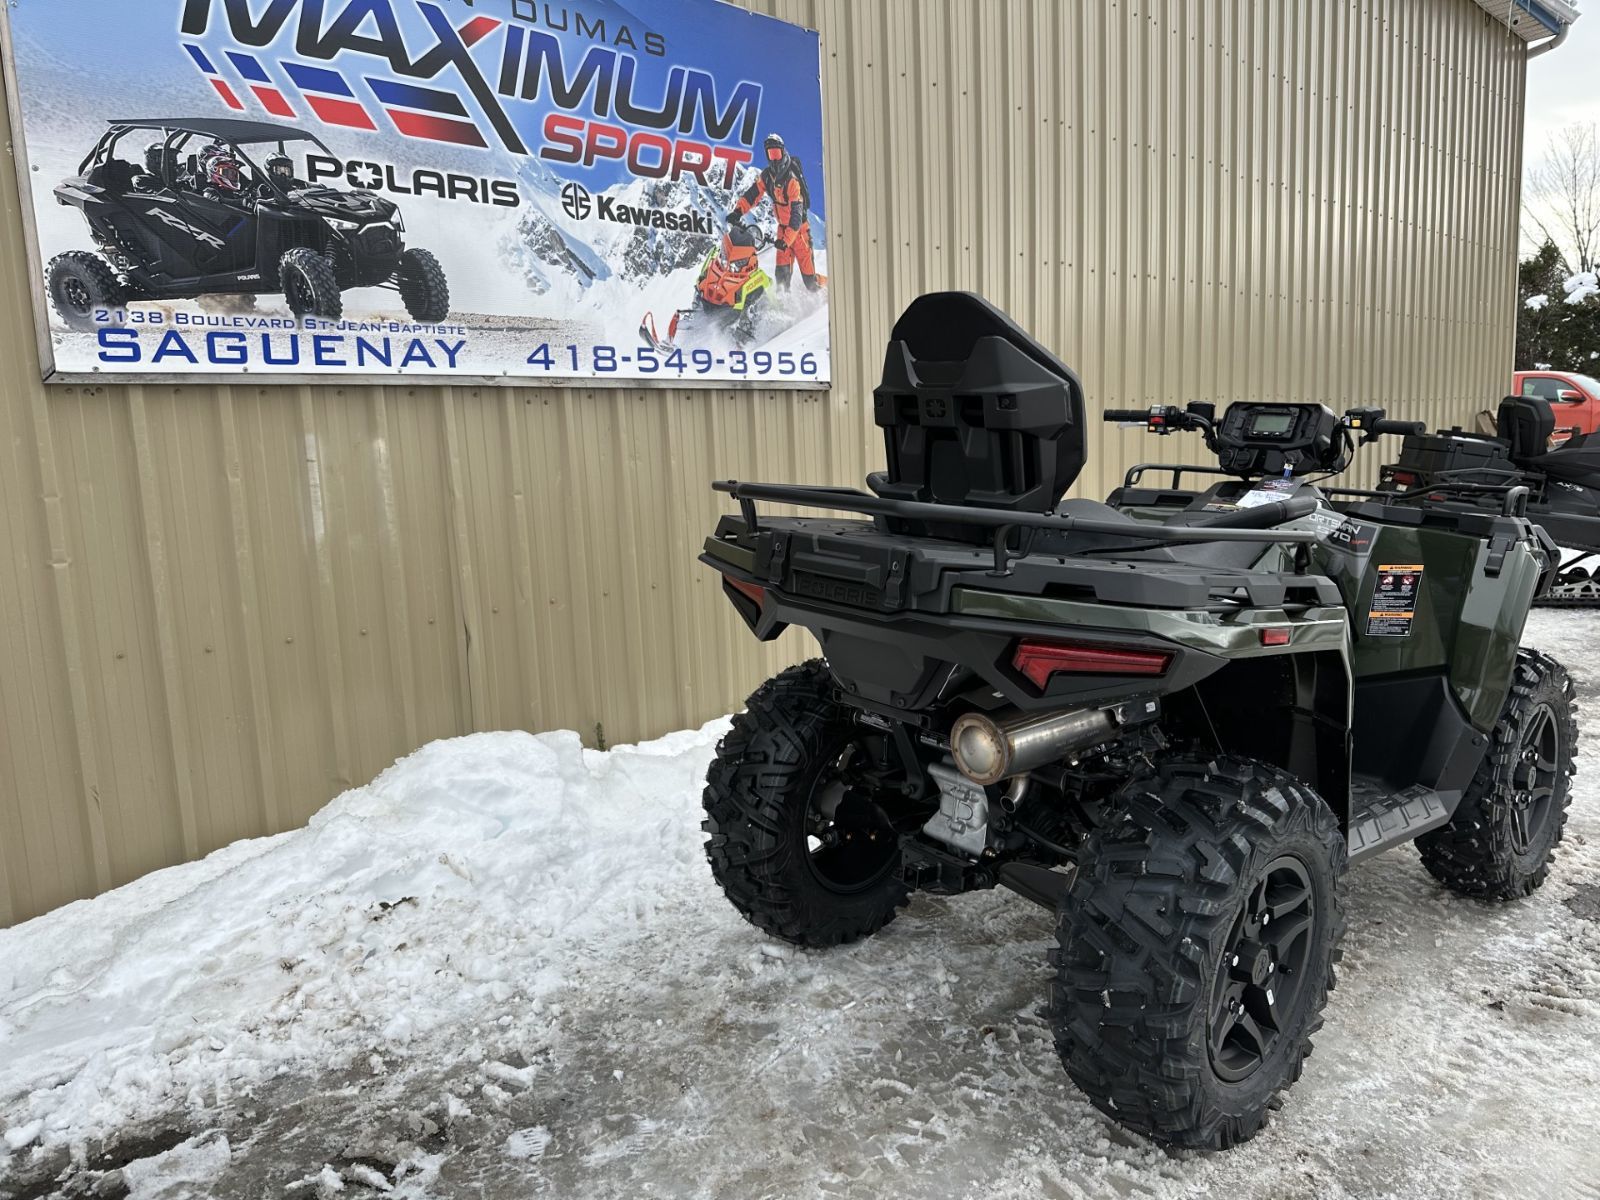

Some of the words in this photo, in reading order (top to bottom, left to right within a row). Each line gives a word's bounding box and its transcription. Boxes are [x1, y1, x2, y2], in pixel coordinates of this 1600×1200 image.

[511, 0, 667, 57] DUMAS
[181, 0, 763, 156] MAXIMUM
[540, 113, 753, 190] SPORT
[306, 153, 520, 207] POLARIS
[598, 194, 714, 235] Kawasaki
[95, 309, 165, 324] 2138
[175, 312, 295, 329] BOULEVARD
[98, 328, 467, 368] SAGUENAY
[526, 342, 818, 375] 418-549-3956
[1309, 513, 1362, 535] ORTSMAN
